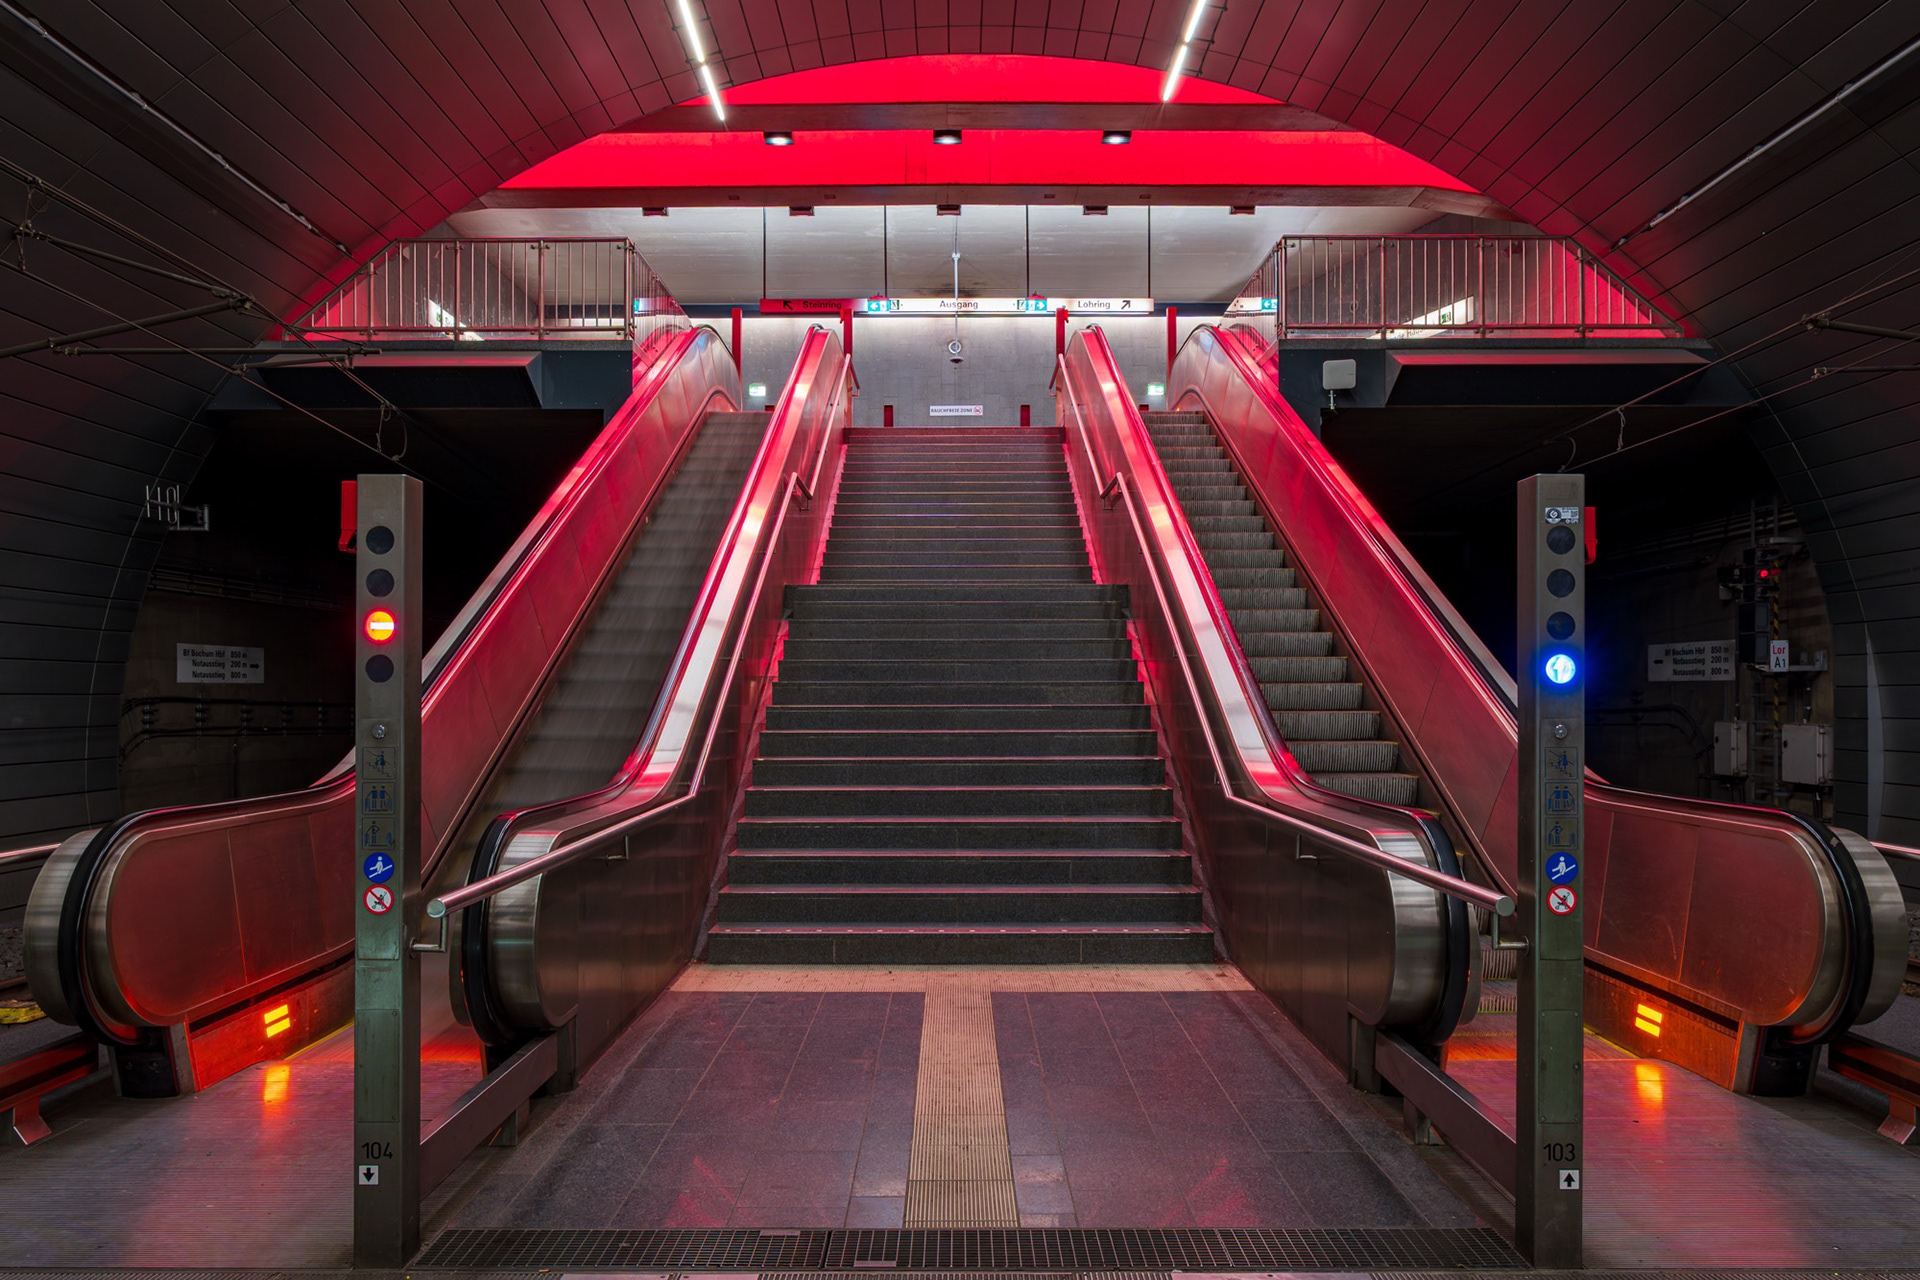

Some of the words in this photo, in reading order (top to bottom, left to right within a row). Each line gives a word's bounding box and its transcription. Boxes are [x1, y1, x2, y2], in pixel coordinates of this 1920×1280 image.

[802, 300, 842, 310] Steinring
[940, 300, 978, 310] Ausgang
[1078, 300, 1110, 310] Lohring
[191, 649, 214, 657] Bochum
[1772, 645, 1786, 655] Lor
[192, 660, 225, 669] Notausstieg
[1673, 657, 1705, 666] Notausstieg
[1775, 656, 1785, 668] A1
[192, 671, 225, 680] Notausstieg
[1673, 669, 1705, 677] Notausstieg
[362, 1141, 393, 1159] 104
[1544, 1143, 1575, 1161] 103
